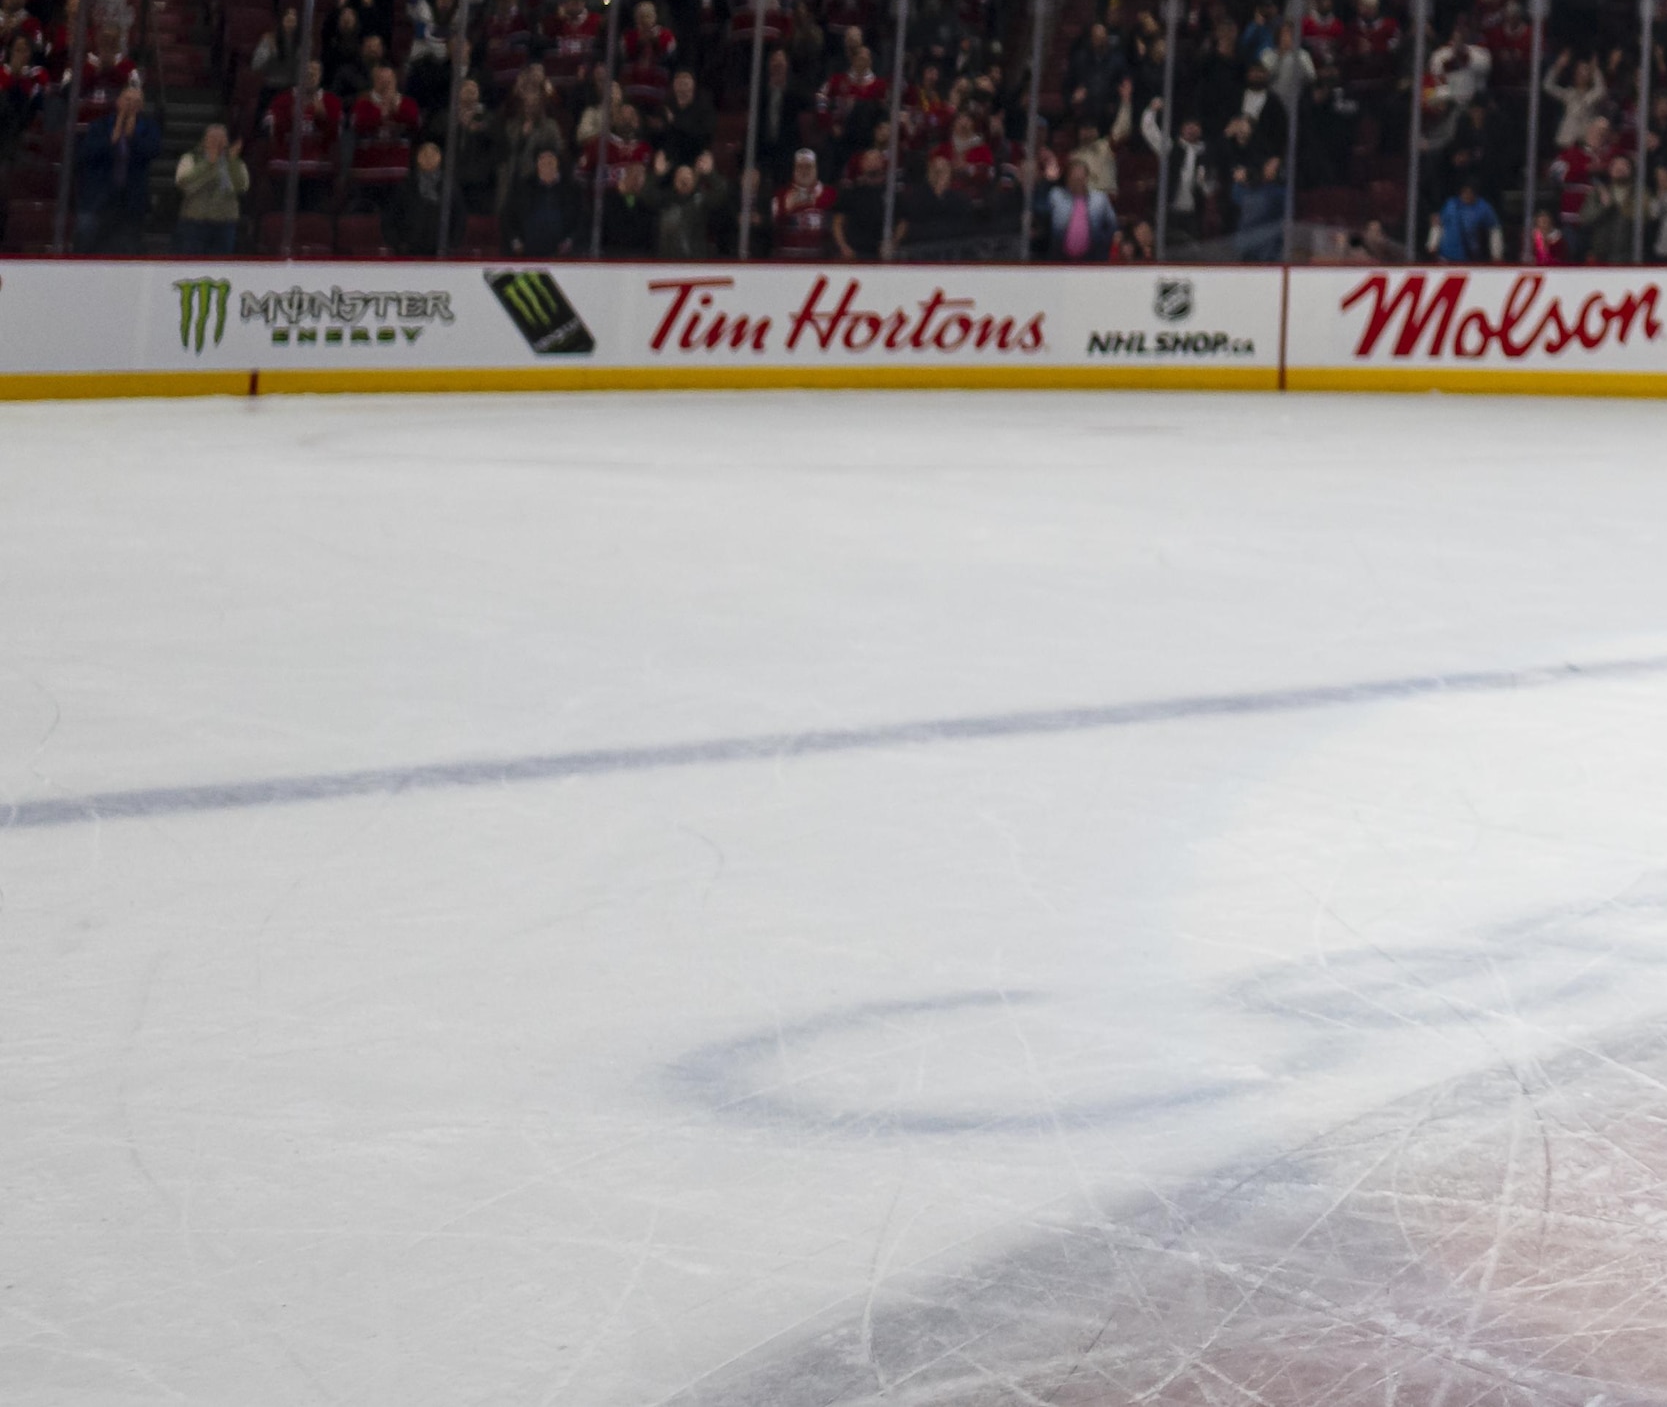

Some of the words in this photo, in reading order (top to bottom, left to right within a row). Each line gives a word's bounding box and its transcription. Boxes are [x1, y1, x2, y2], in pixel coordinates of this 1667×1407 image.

[240, 287, 456, 323] MONSTER
[648, 276, 770, 353] Tim
[784, 274, 1046, 352] Hortons
[1340, 273, 1664, 359] Molson
[271, 326, 423, 345] ENERGY
